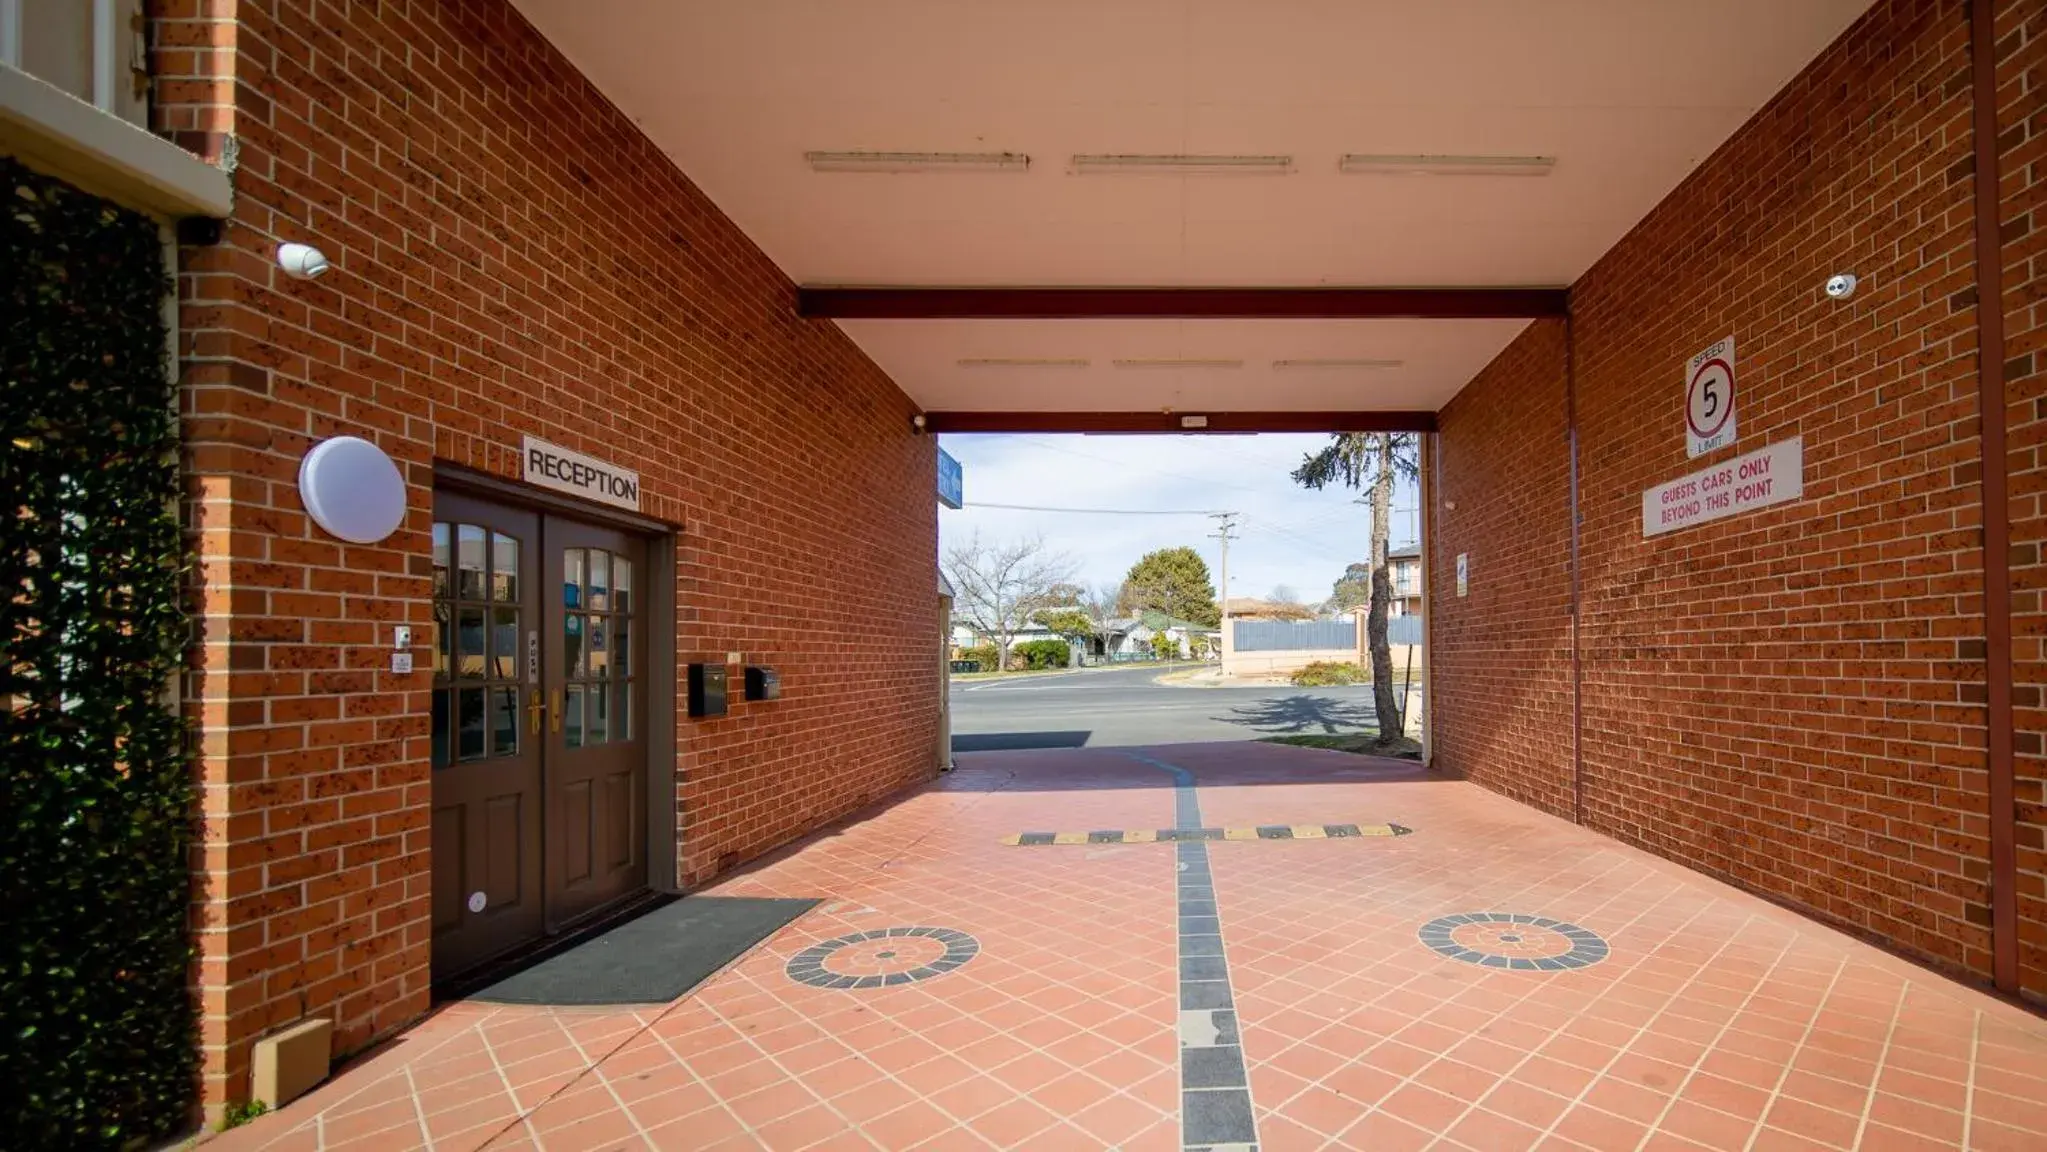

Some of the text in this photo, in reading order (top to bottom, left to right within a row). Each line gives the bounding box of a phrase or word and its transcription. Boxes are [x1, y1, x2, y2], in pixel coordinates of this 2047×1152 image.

[1694, 342, 1726, 368] SPEED
[1704, 378, 1718, 418] 5
[1698, 435, 1724, 454] LIMIT
[529, 448, 637, 502] RECEPTION
[1661, 455, 1771, 504] GUESTS CARS ONLY
[1661, 478, 1773, 524] BEYOND THIS POINT
